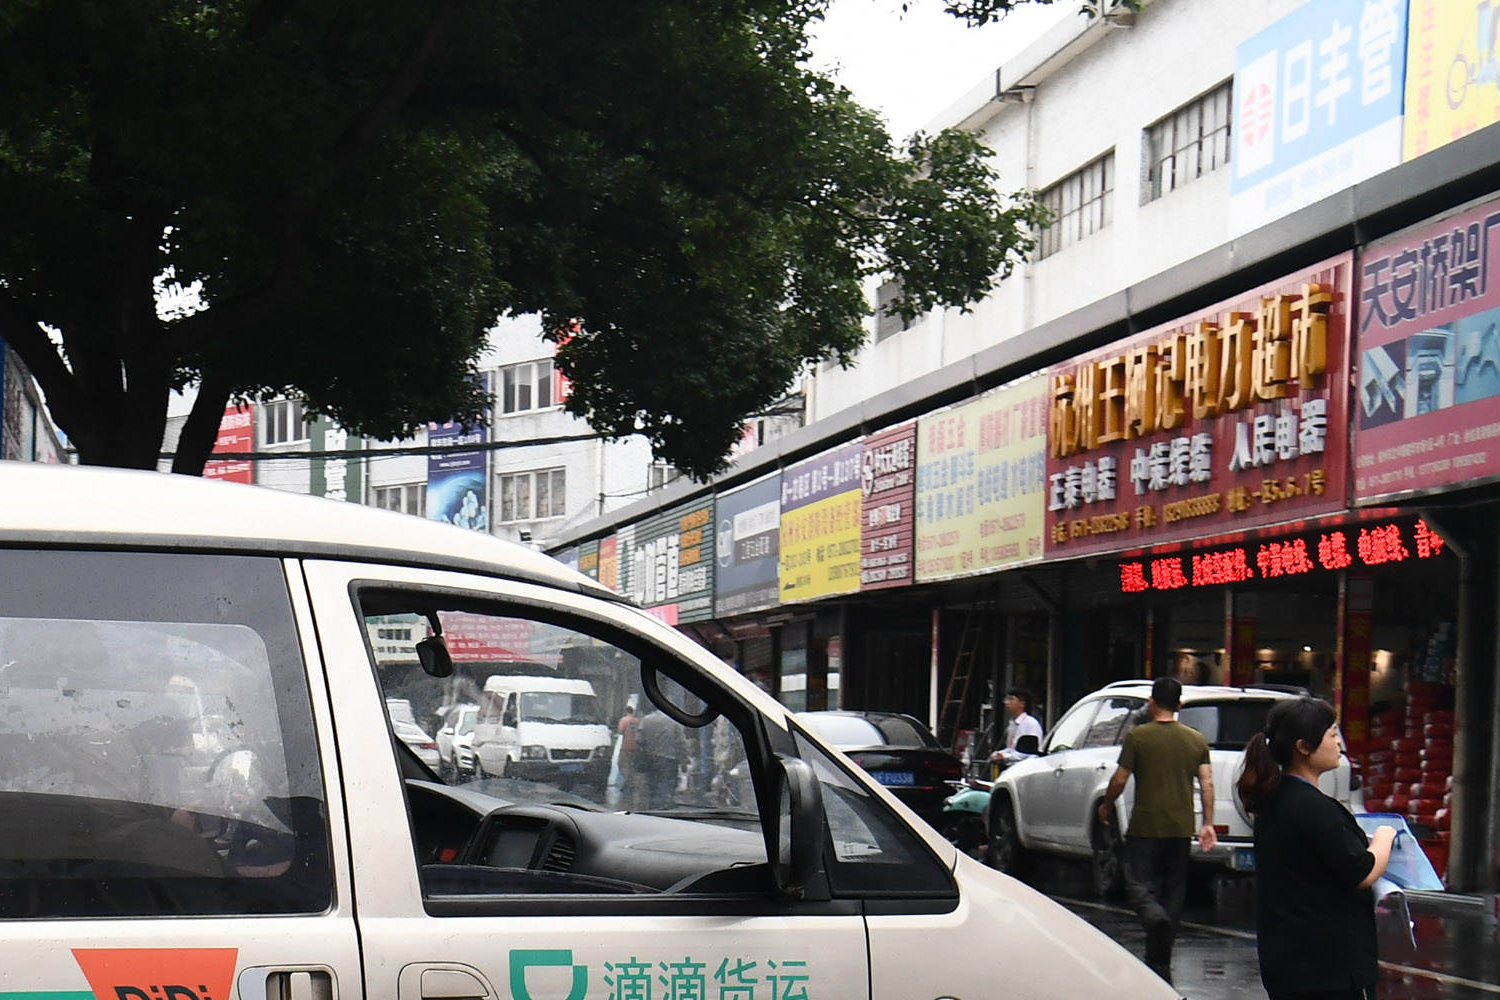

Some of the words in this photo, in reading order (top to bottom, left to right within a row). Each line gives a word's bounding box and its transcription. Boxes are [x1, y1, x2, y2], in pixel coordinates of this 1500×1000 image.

[1281, 2, 1399, 145] 日丰管
[1361, 211, 1500, 335] 天安桥架厂
[1229, 399, 1328, 473] 人民电器
